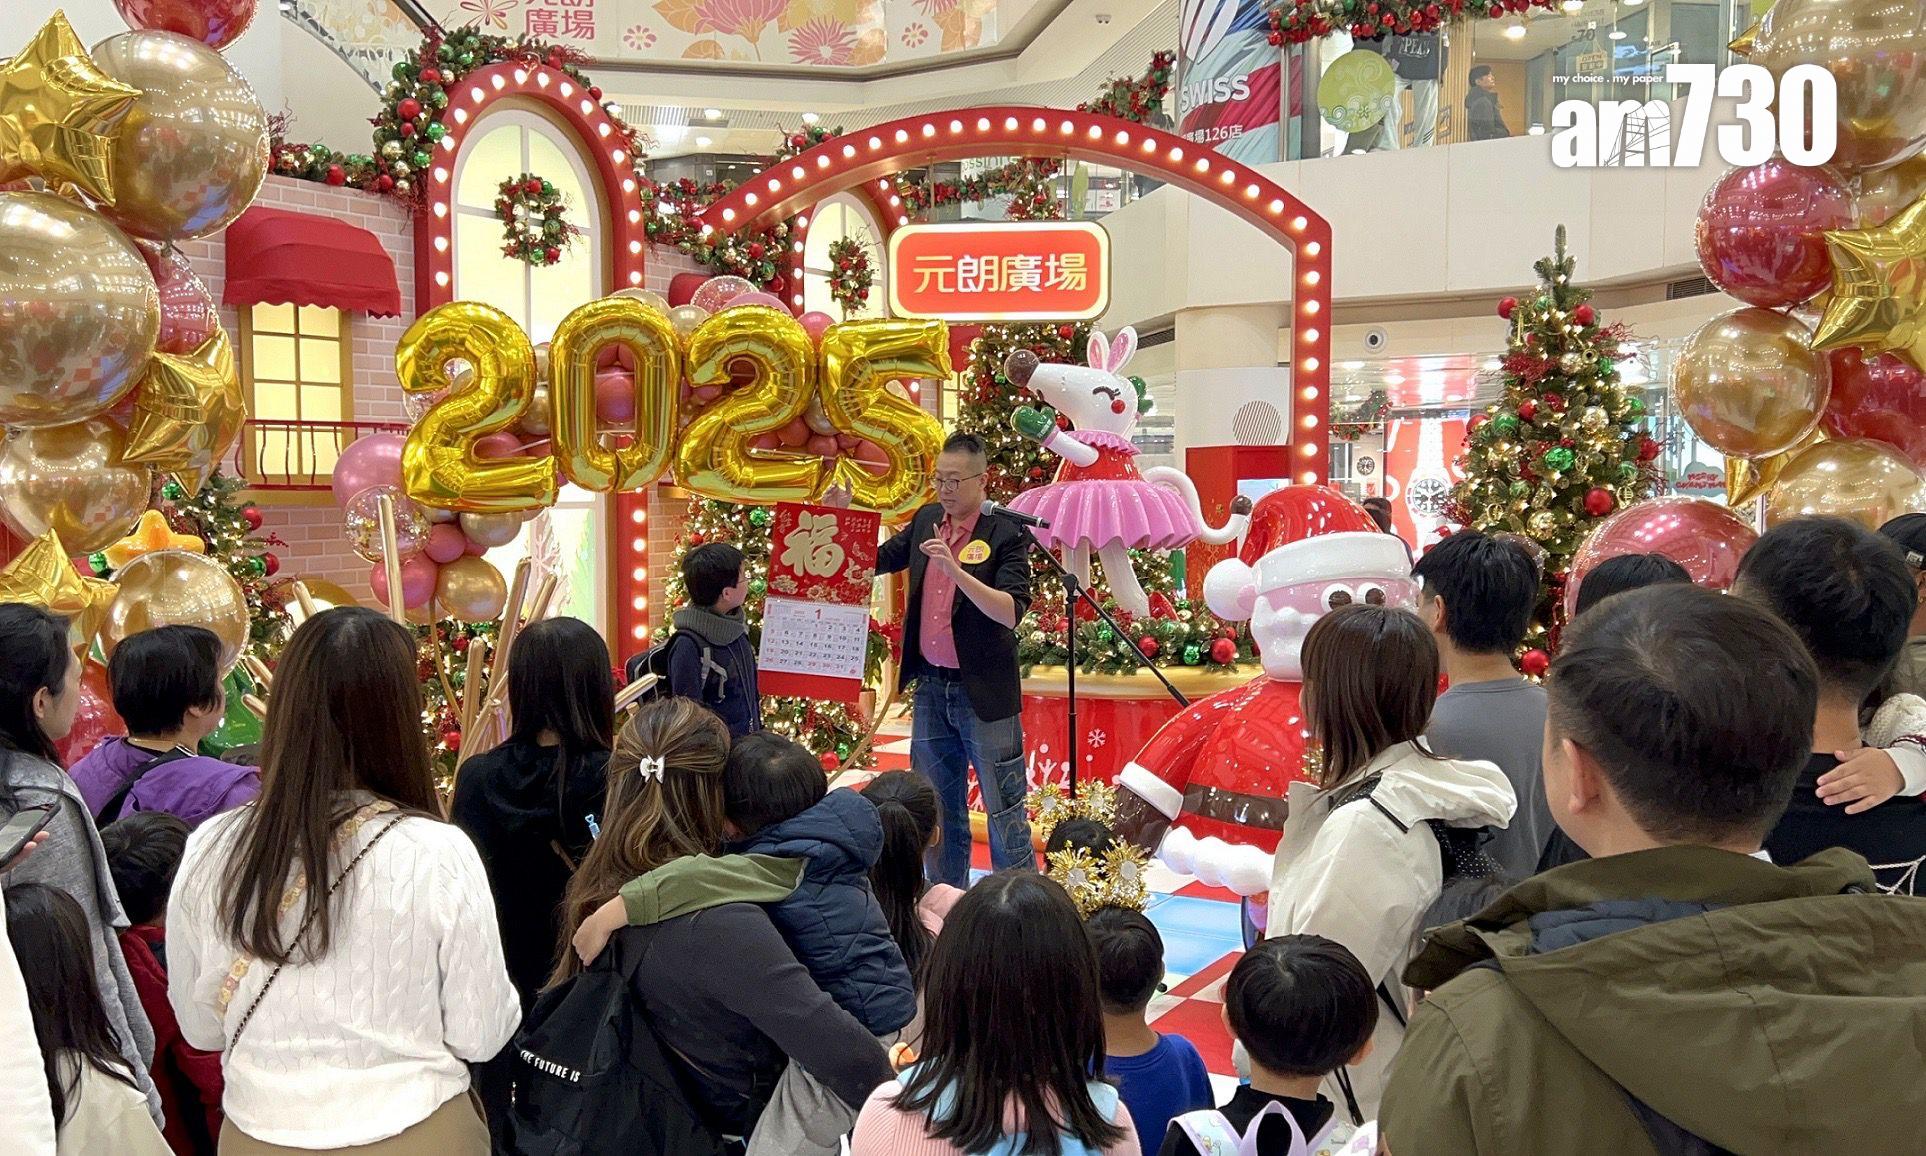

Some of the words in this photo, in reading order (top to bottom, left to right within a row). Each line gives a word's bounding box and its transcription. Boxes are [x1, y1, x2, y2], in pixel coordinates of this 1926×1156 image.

[525, 8, 596, 40] 廣場
[1180, 75, 1251, 113] SWISS
[1181, 124, 1243, 144] 廣場126店
[913, 253, 1088, 293] 元朗廣場
[395, 296, 952, 524] 2025
[780, 510, 845, 578] 福
[815, 608, 822, 620] 1
[520, 1050, 535, 1064] THE
[534, 1057, 569, 1079] FUTURE
[570, 1070, 581, 1083] IS
